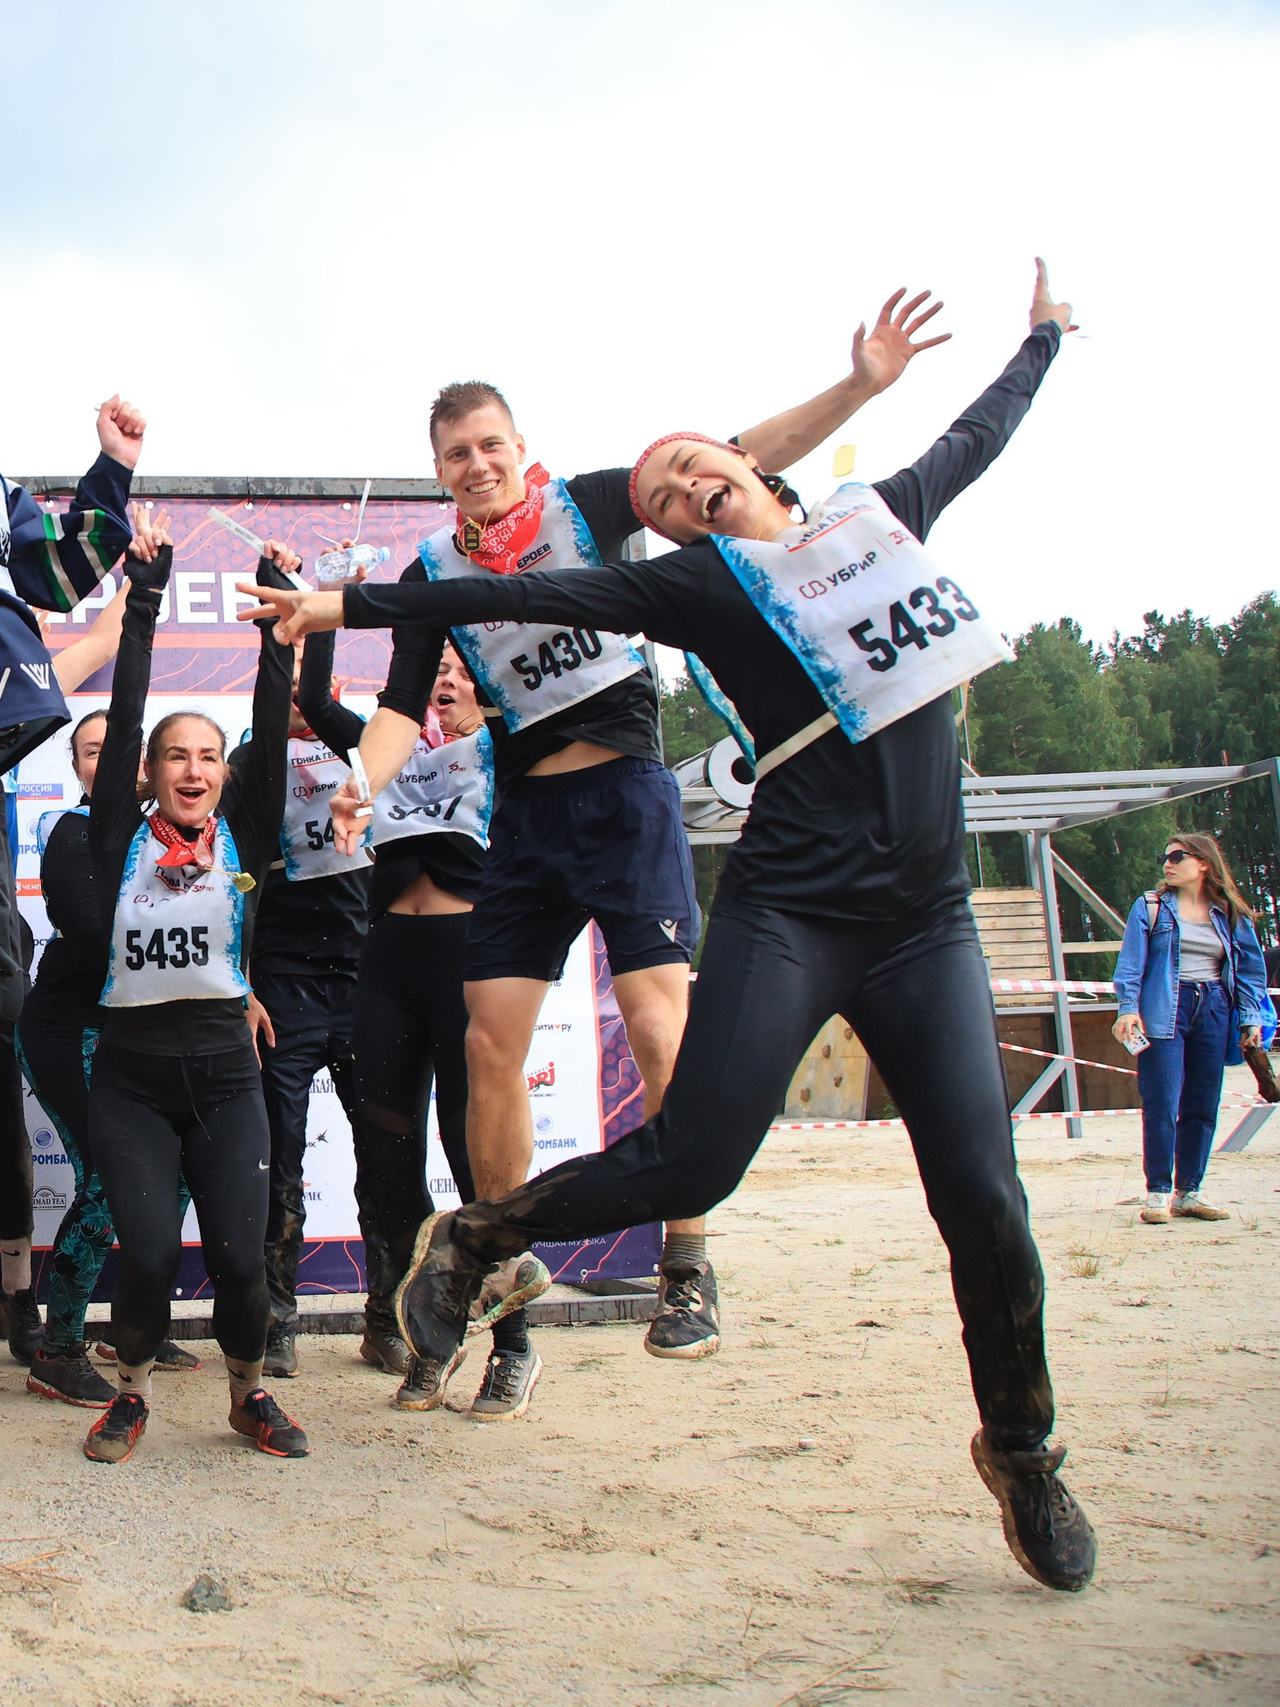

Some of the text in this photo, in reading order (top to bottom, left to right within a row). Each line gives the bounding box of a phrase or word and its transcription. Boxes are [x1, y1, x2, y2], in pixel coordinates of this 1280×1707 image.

[517, 543, 551, 569] ЕРОЕВ
[847, 576, 980, 673] 5433
[509, 628, 602, 691] 5430
[291, 754, 321, 766] ГОНКА
[19, 784, 53, 793] РОССИЯ
[305, 817, 336, 851] 54
[125, 926, 209, 971] 5435
[52, 1194, 65, 1205] TEA
